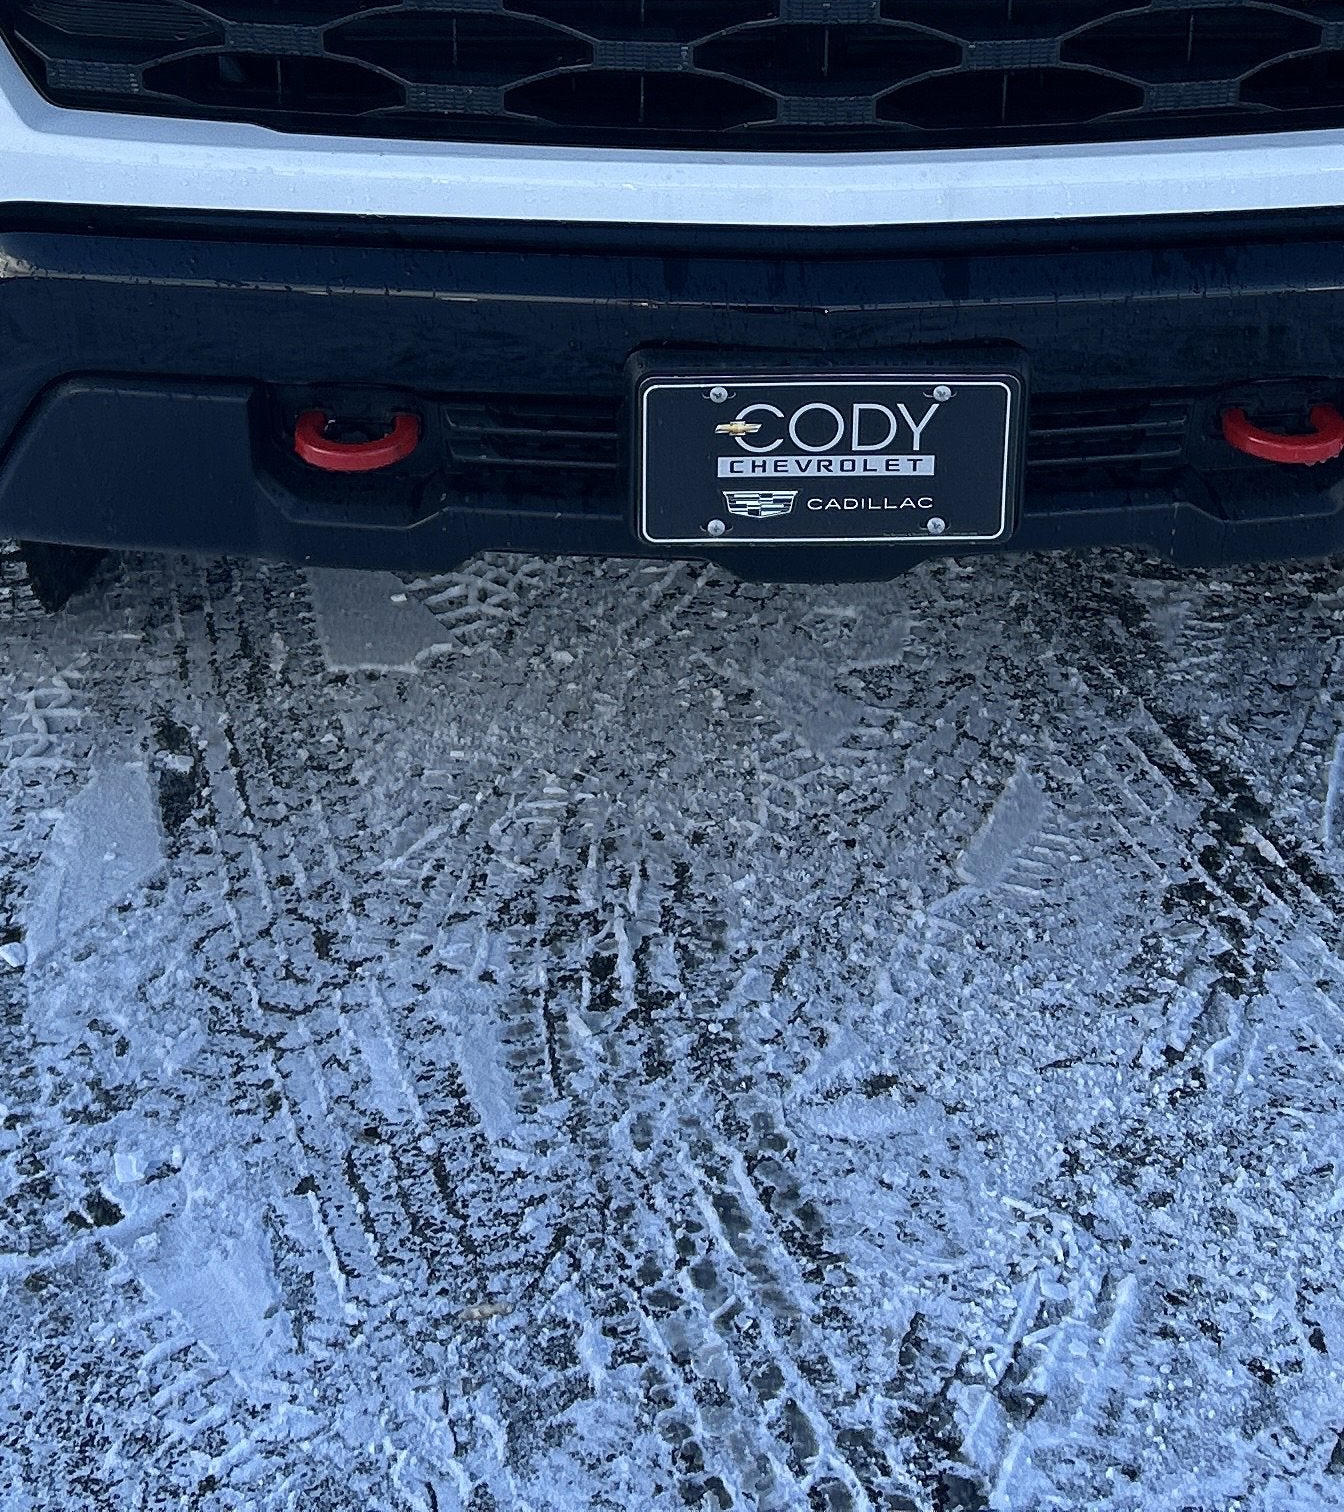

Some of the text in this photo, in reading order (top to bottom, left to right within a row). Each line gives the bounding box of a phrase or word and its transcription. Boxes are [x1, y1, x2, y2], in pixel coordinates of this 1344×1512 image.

[734, 402, 941, 453] CODY
[728, 457, 924, 474] CHEVROLET
[806, 496, 934, 511] CADILLAC
